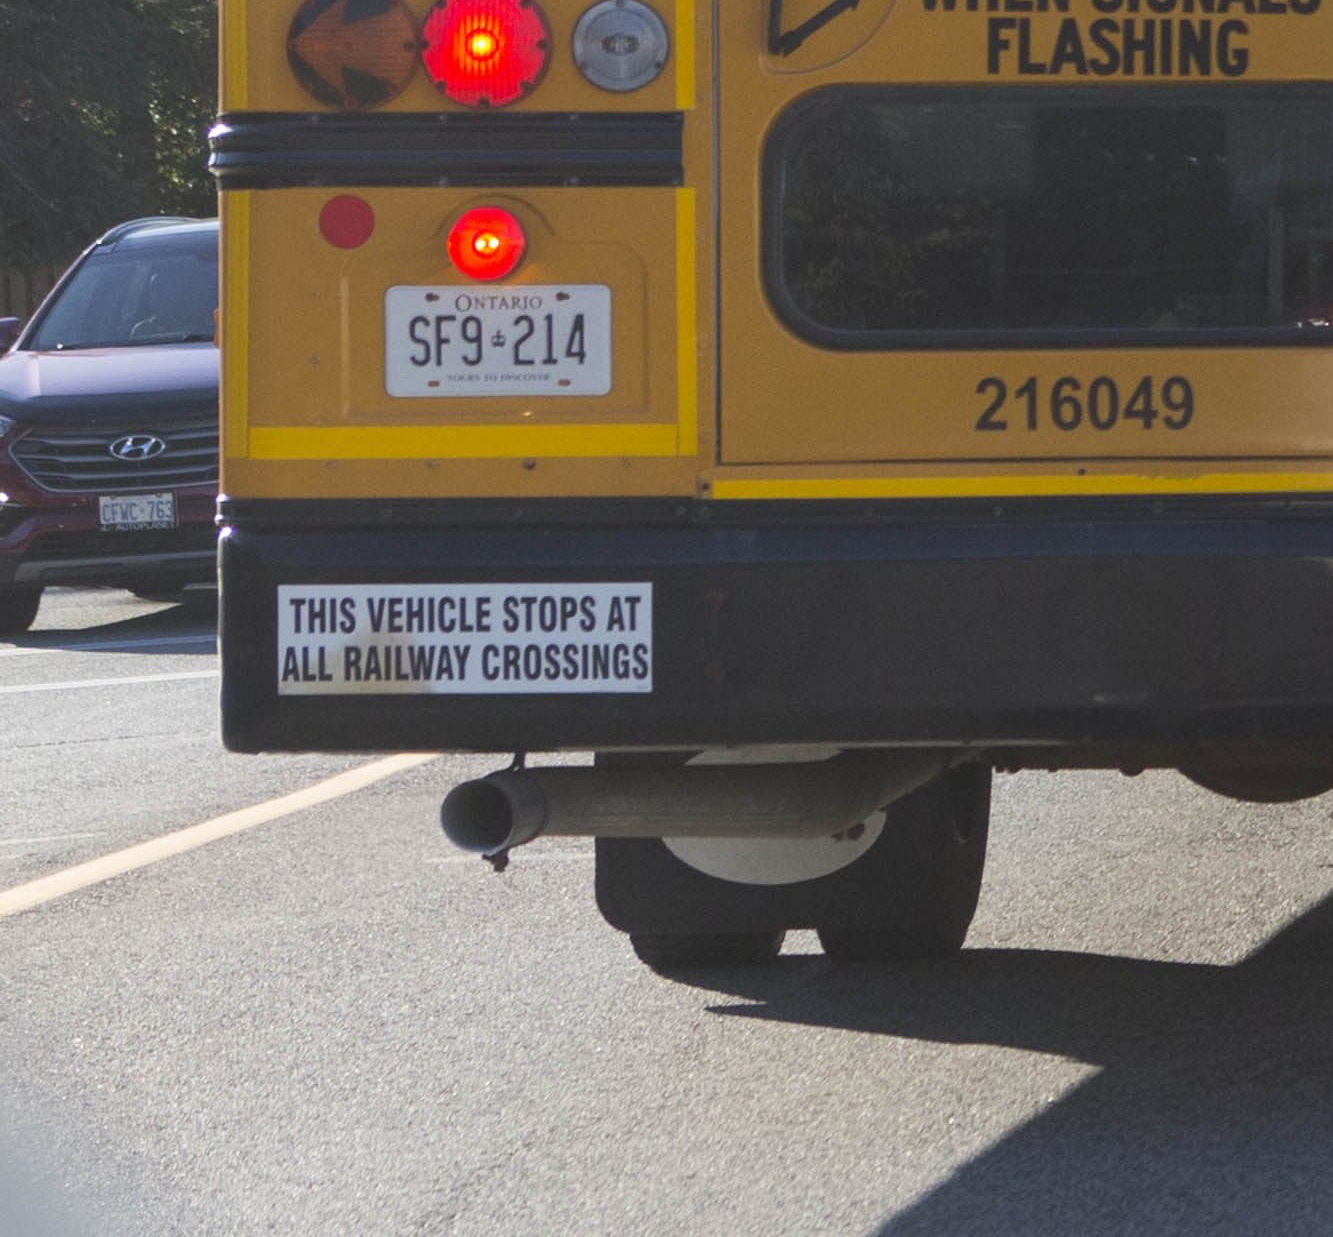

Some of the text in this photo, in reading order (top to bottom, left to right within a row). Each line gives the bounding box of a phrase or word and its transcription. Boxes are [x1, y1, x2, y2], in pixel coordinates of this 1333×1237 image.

[987, 17, 1249, 77] FLASHING
[454, 294, 543, 312] ONTARIO
[974, 375, 1195, 432] 216049
[289, 595, 642, 634] THIS VEHICLE STOPS AT
[281, 643, 649, 682] ALL RAILWAY CROSSINGS
